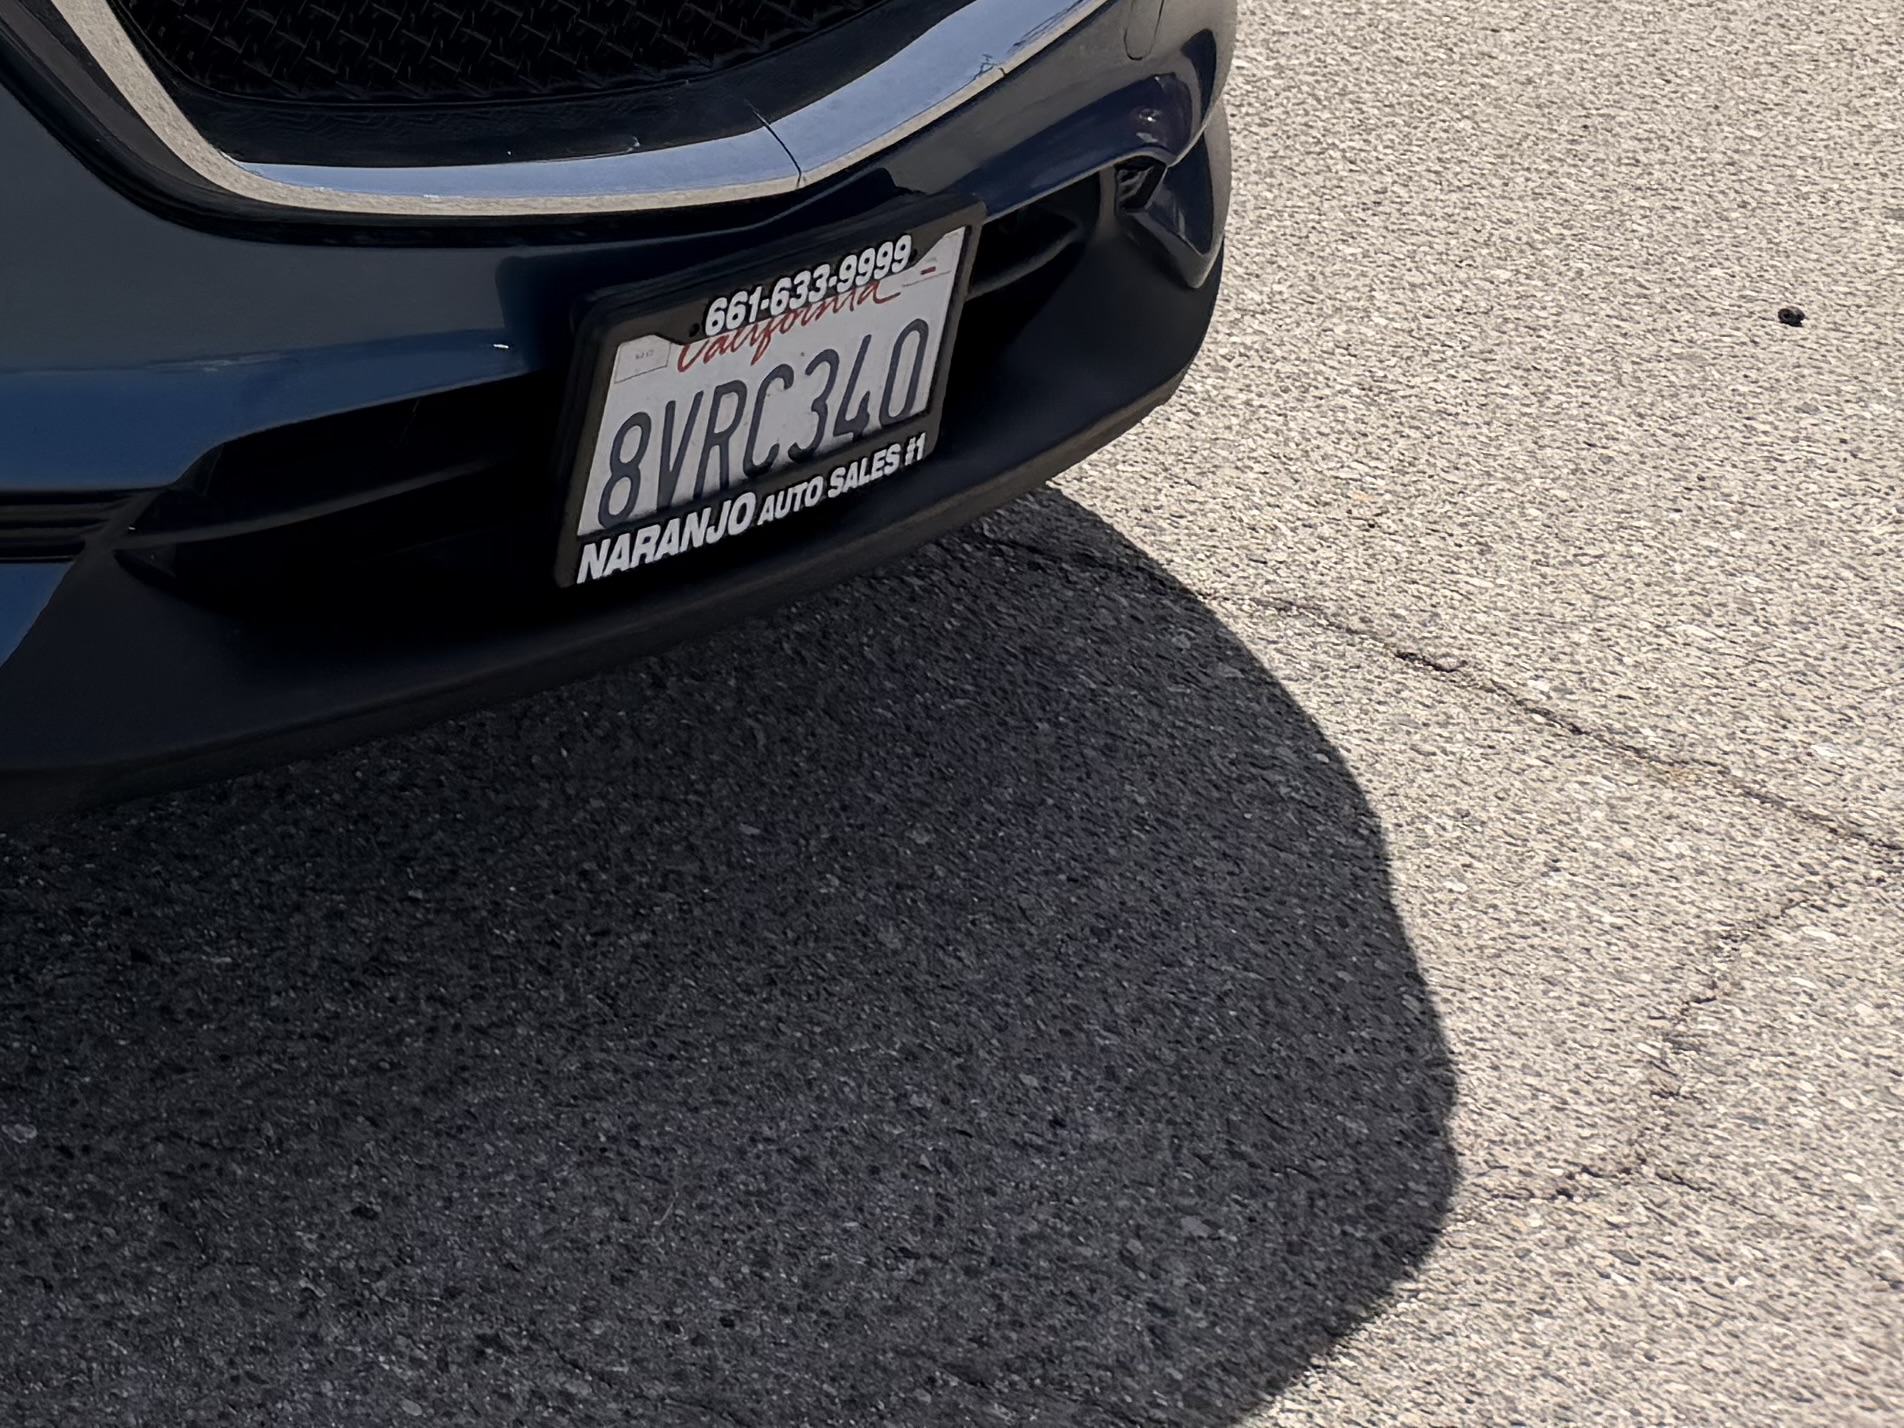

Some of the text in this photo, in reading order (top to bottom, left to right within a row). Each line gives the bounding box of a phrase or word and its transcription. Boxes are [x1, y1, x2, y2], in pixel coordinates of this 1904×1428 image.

[704, 234, 913, 337] 661-633-9999
[597, 318, 930, 530] 8VRC340
[576, 432, 927, 585] NARANJO AUTO SALES #1
